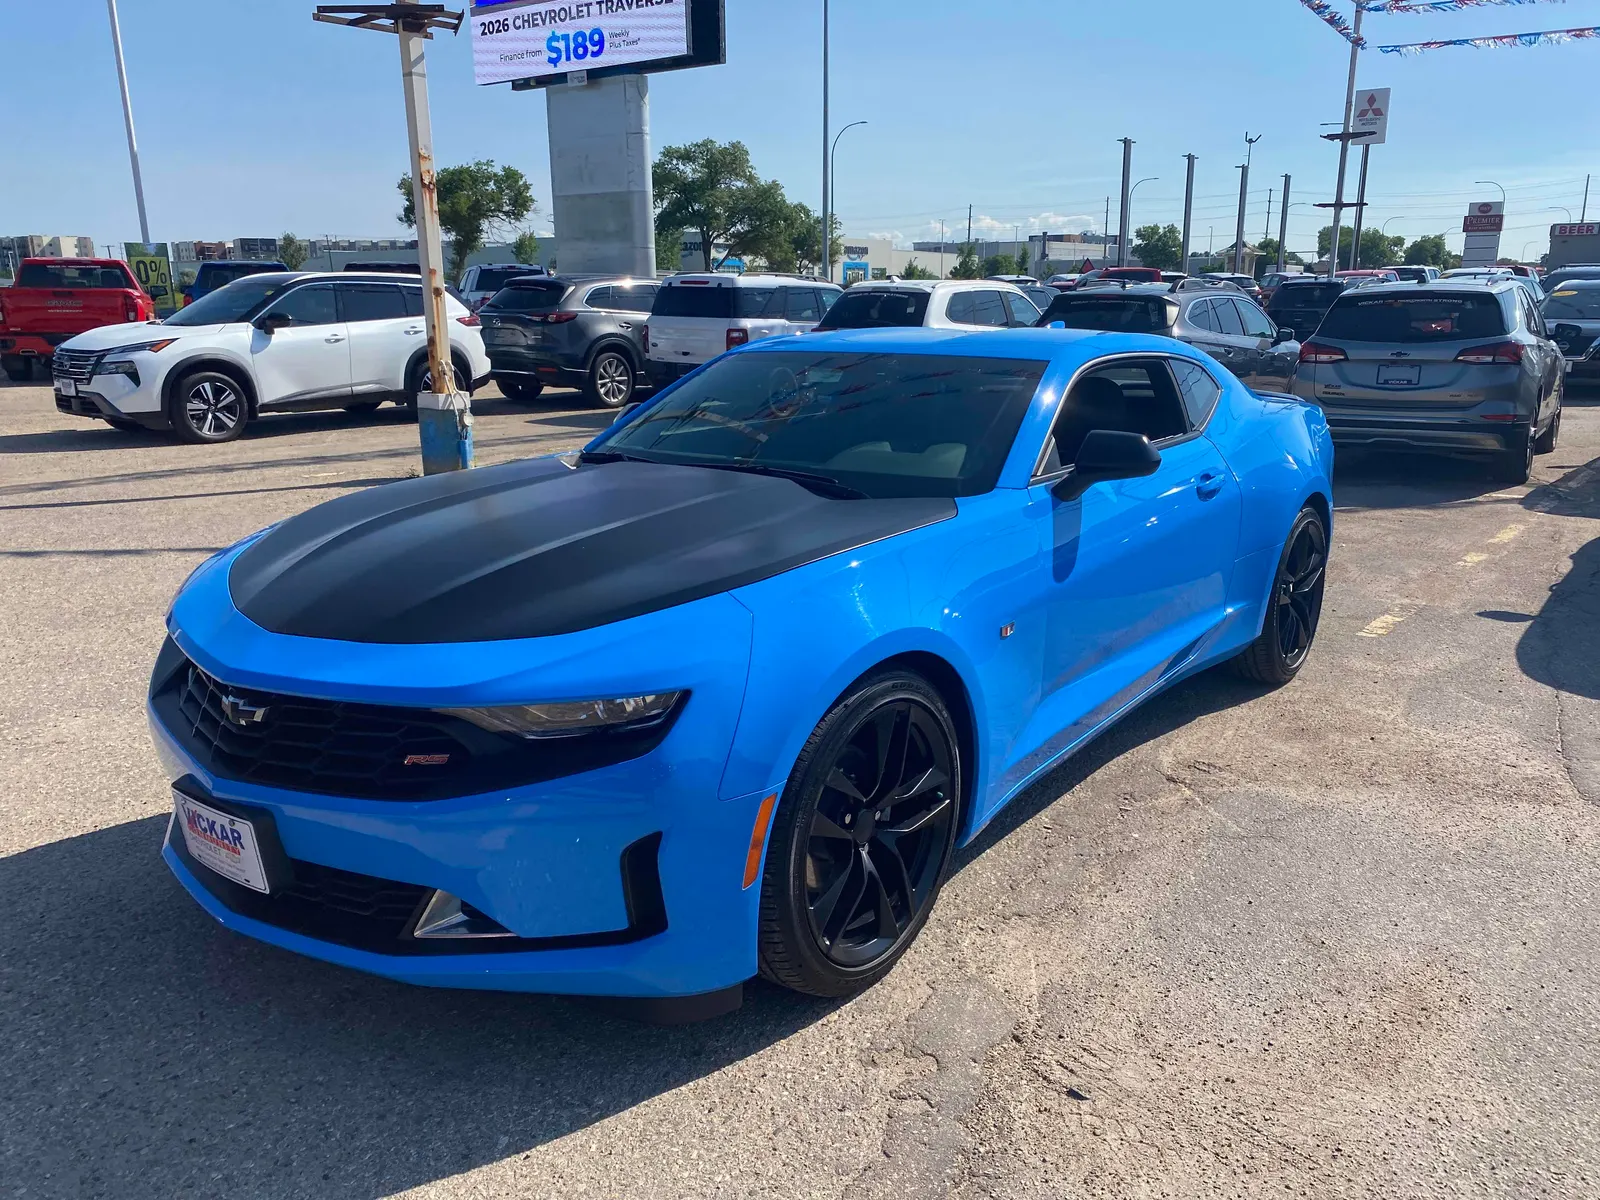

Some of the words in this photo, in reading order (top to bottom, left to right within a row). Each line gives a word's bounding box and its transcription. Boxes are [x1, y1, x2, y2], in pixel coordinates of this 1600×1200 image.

[480, 18, 509, 36] 2026
[513, 2, 593, 30] CHEVROLET
[596, 0, 673, 15] TRAVE
[608, 29, 630, 39] Weekly
[546, 27, 605, 68] $189
[499, 50, 525, 62] Finance
[526, 49, 542, 58] from
[1467, 216, 1500, 224] PREMIER
[1558, 225, 1594, 235] BEER
[844, 246, 868, 255] amazon
[136, 260, 167, 285] 0%
[404, 754, 450, 765] RS
